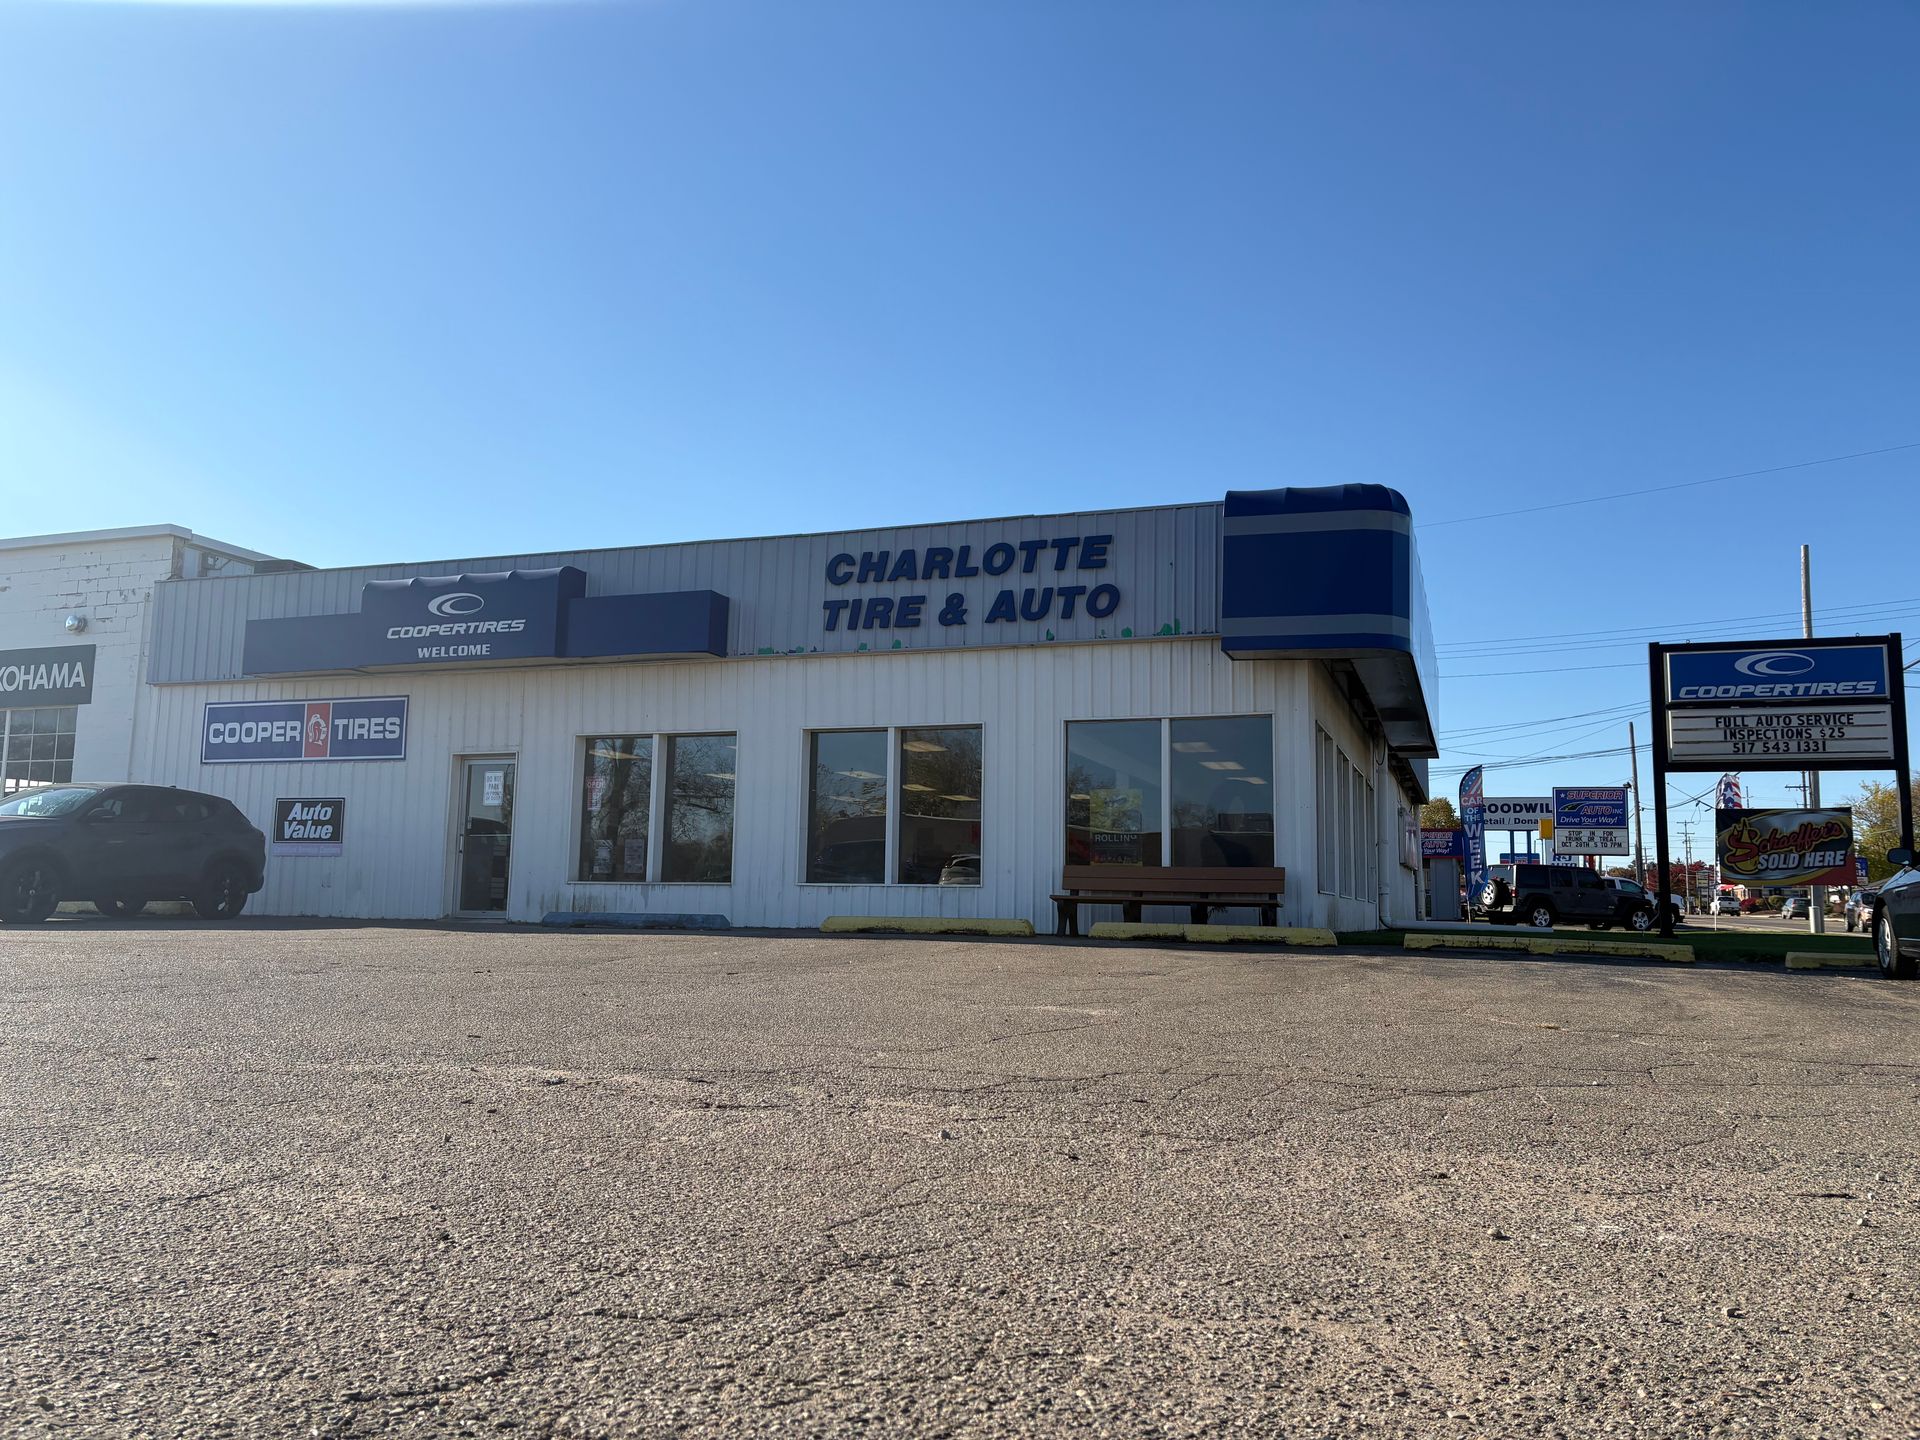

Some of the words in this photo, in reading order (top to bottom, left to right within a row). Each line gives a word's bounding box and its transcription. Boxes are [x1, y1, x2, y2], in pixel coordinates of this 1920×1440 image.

[826, 534, 1113, 586] CHARLOTTE
[823, 595, 926, 631] TIRE
[938, 592, 968, 627] &
[984, 583, 1121, 623] AUTO
[386, 619, 526, 639] COOPERTIRES
[417, 644, 491, 658] WELCOME
[1679, 680, 1878, 698] COOPERTIRES
[1715, 716, 1749, 728] FULL
[1756, 715, 1792, 726] AUTO
[1797, 714, 1854, 726] SERVICE
[209, 720, 301, 744] COOPER
[333, 717, 400, 740] TIRES
[1723, 728, 1812, 740] INSPECTIONS
[1820, 727, 1846, 738] $25
[1732, 742, 1755, 753] 517
[1762, 742, 1790, 752] 543
[1797, 740, 1827, 752] 1331
[1461, 796, 1482, 806] CAR
[1567, 790, 1624, 800] SUPERIOR
[287, 802, 333, 820] Auto
[1581, 806, 1612, 815] AUTO
[1598, 816, 1618, 824] Way!
[284, 820, 333, 839] Value
[1726, 821, 1843, 863] Schaeffer's
[1464, 823, 1485, 884] WEEK
[1758, 852, 1800, 870] SOLD
[1804, 850, 1846, 867] HERE
